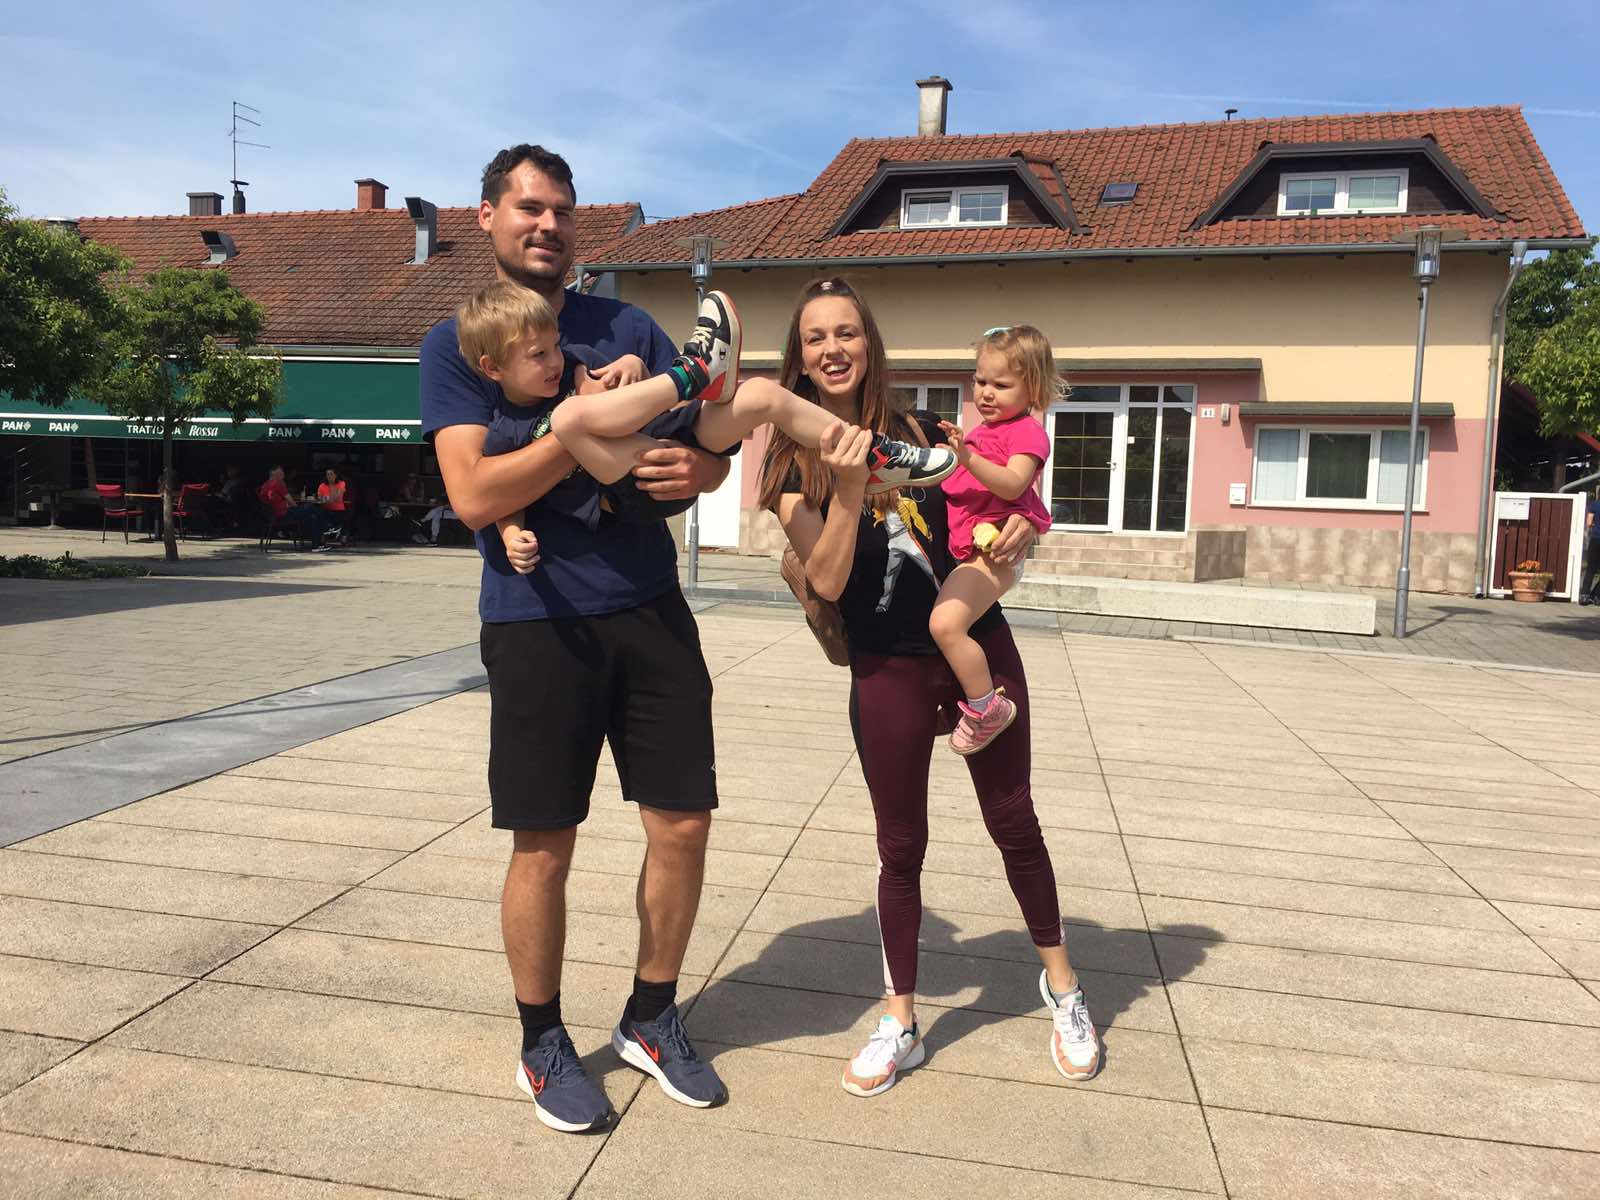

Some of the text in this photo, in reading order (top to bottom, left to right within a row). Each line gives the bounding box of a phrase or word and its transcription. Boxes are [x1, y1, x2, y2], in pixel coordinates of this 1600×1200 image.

[2, 421, 24, 431] PAN
[49, 423, 72, 433] PAN
[126, 424, 219, 437] TRATTOA Rossa
[268, 427, 293, 438] PAN
[321, 428, 346, 438] PAN
[376, 428, 400, 439] PAN
